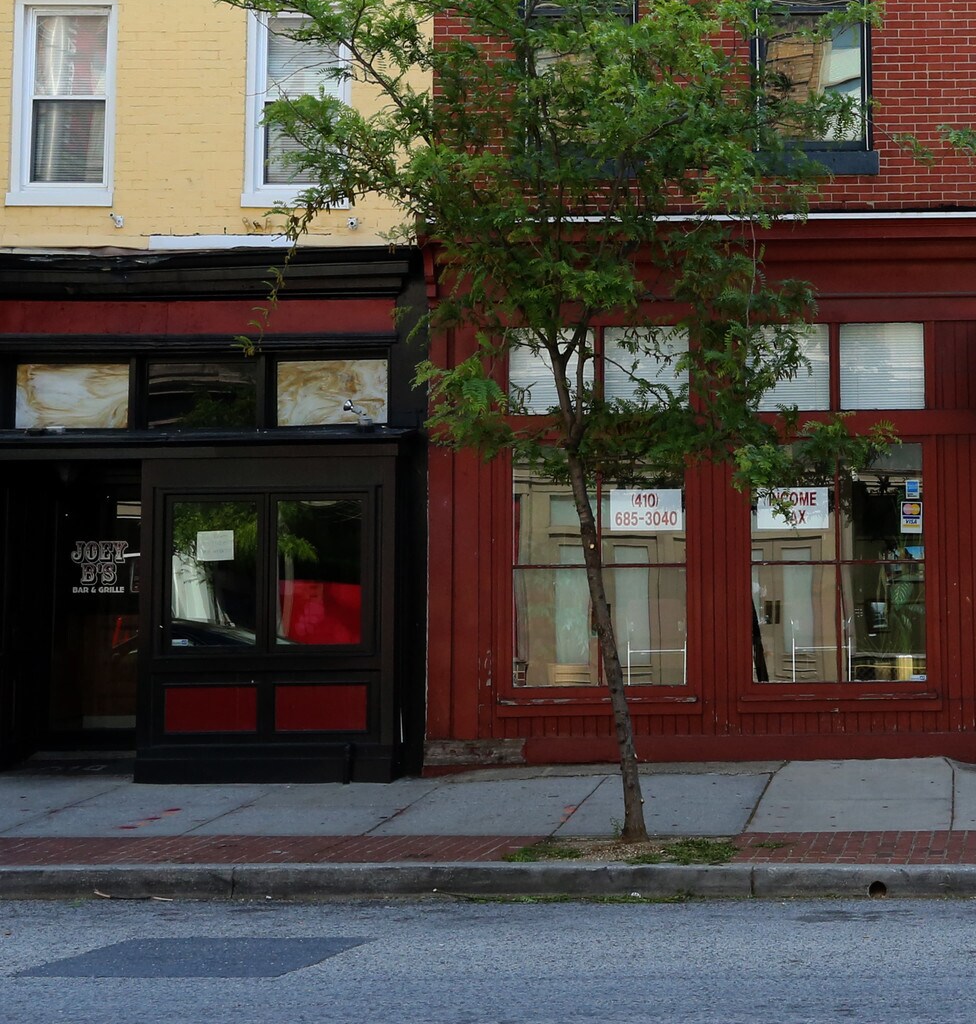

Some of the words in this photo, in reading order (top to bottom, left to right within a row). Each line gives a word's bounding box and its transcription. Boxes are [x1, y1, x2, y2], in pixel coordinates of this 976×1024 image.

[631, 493, 659, 507] (410)
[615, 511, 678, 526] 685-3040
[71, 540, 129, 563] JOEY
[80, 562, 118, 586] B'S
